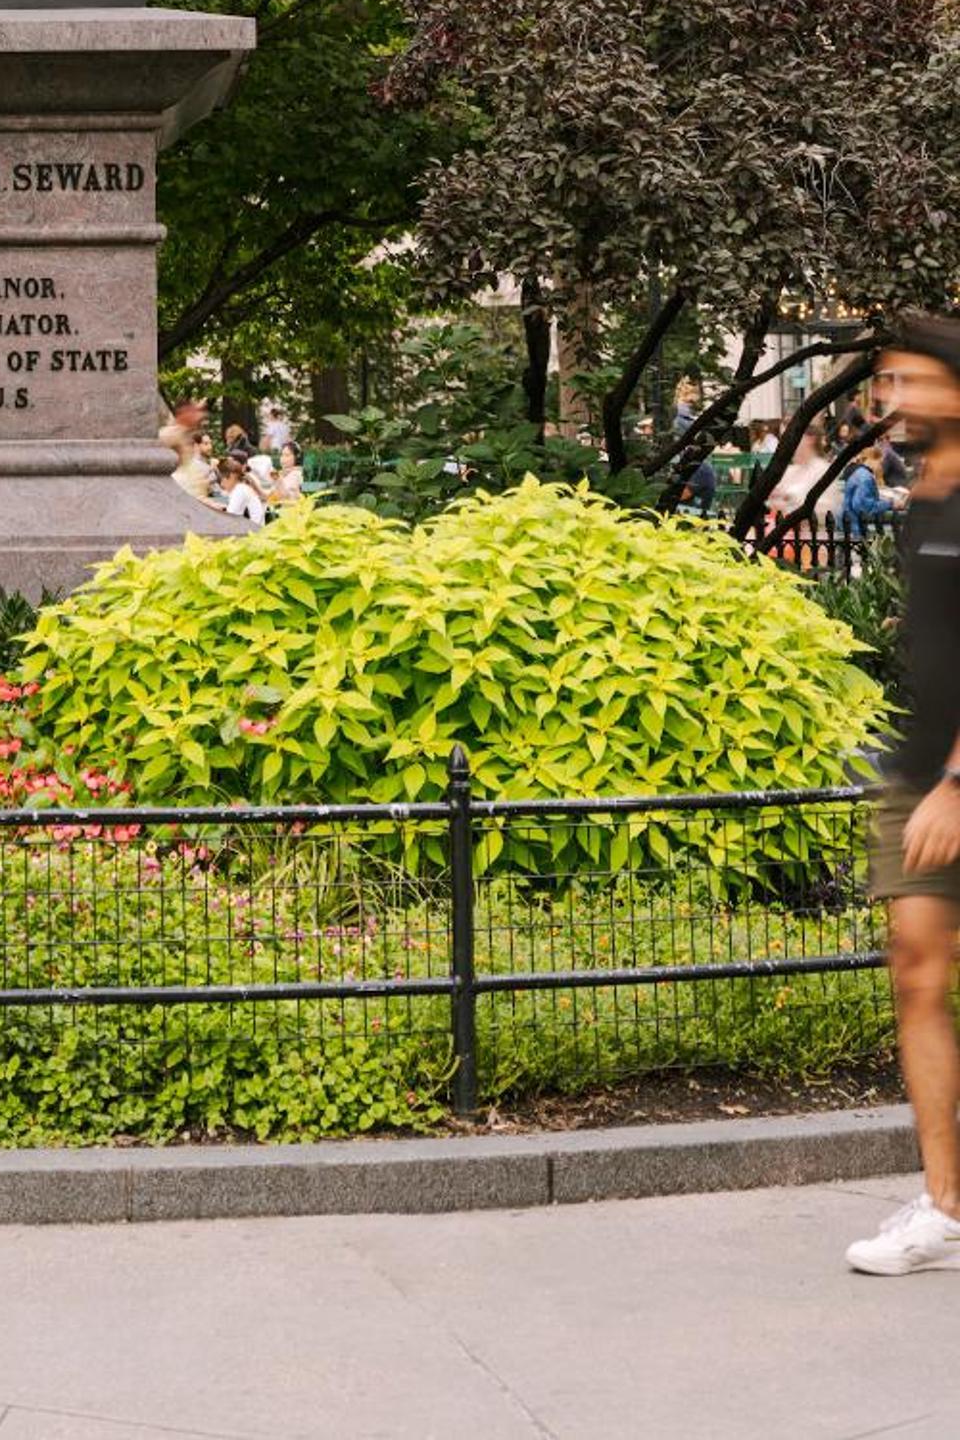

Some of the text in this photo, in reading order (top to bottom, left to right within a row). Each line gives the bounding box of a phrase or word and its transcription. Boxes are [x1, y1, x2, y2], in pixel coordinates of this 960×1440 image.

[13, 163, 144, 191] SEWARD
[7, 350, 40, 372] OF
[50, 350, 128, 372] STATE
